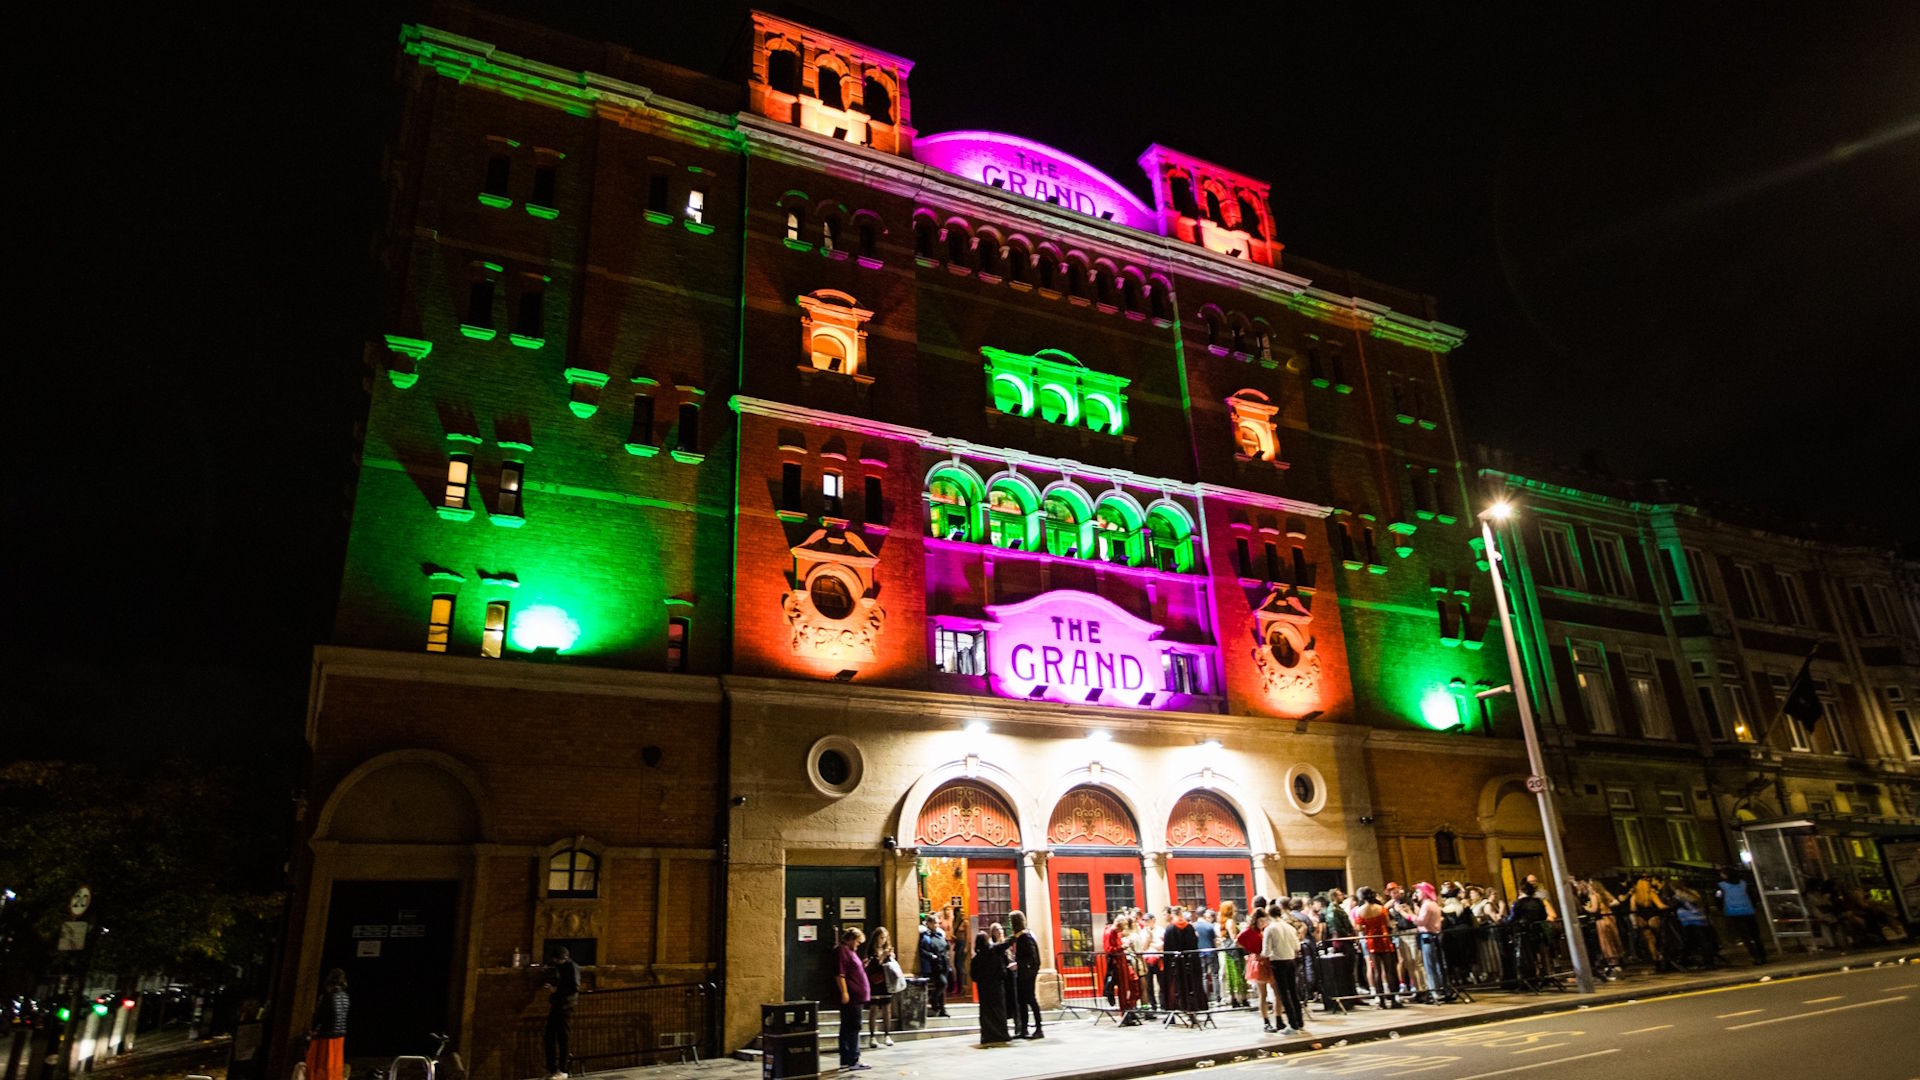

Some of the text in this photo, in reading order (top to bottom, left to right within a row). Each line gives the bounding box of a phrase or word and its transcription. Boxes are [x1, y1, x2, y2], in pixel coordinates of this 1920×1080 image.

[1016, 152, 1059, 180] THE
[1051, 616, 1101, 643] THE
[1011, 643, 1143, 690] GRAND
[1528, 779, 1542, 788] 20
[73, 893, 89, 908] 20
